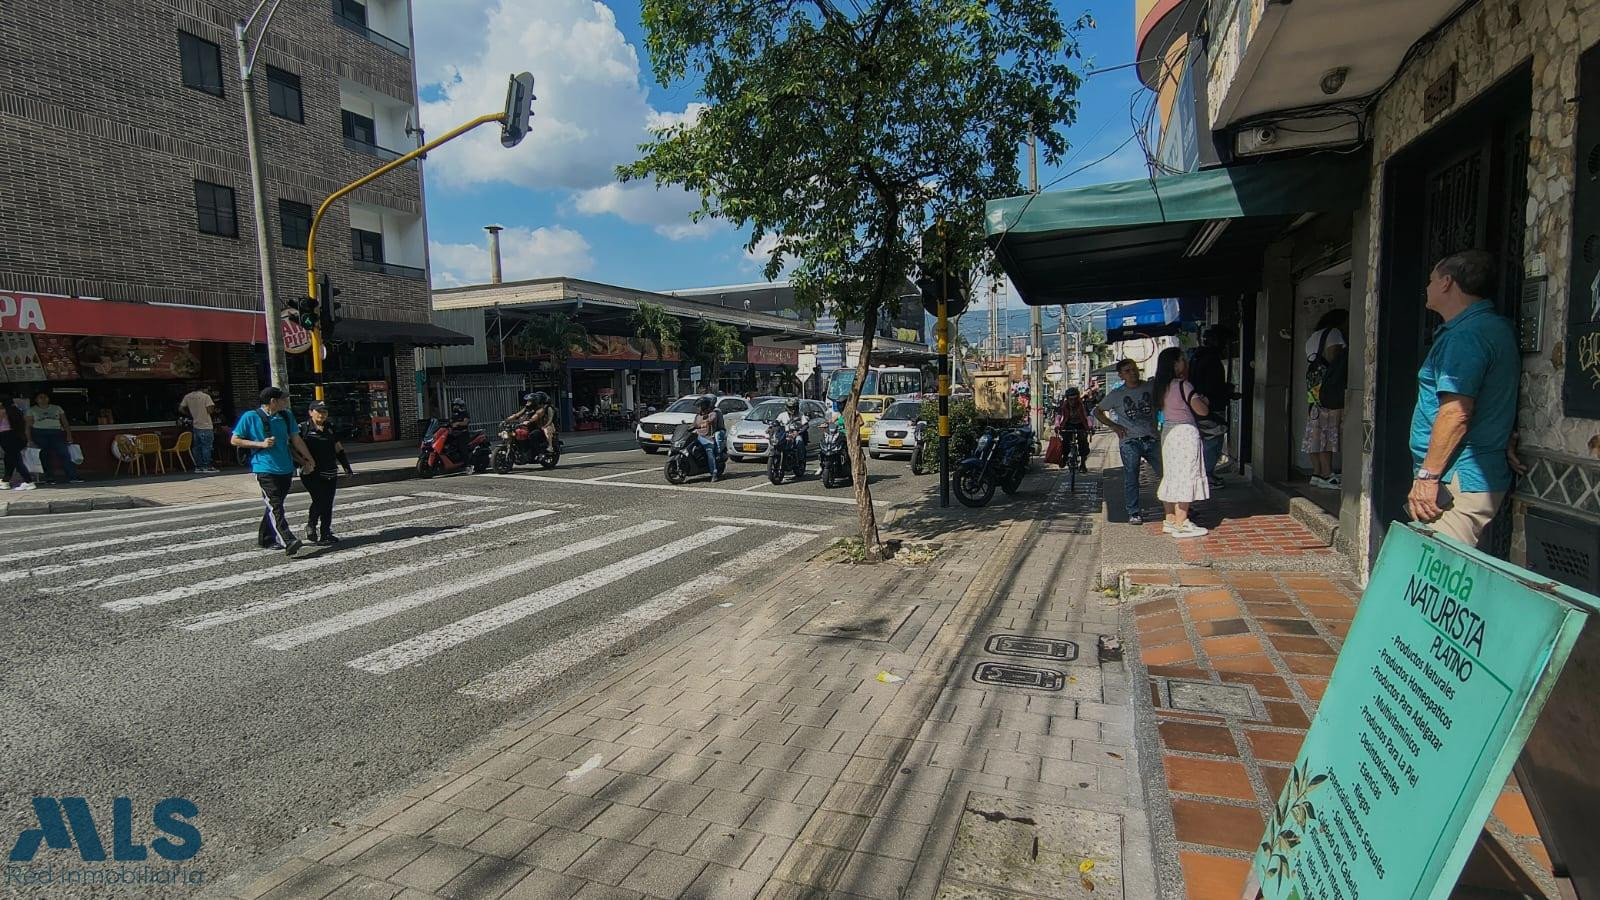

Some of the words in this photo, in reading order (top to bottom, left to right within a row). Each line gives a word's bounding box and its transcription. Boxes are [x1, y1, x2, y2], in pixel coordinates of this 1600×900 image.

[1417, 542, 1474, 602] Tienda
[1403, 574, 1486, 657] NATURISTA
[1422, 662, 1456, 701] Naturales
[1429, 635, 1473, 683] PLATINO
[1398, 694, 1413, 717] Para
[1411, 711, 1444, 752] Adelgazar
[1407, 675, 1453, 731] Homeopaticos
[1385, 737, 1399, 762] Para
[1397, 753, 1407, 772] La
[1404, 764, 1420, 789] Piel
[1315, 874, 1322, 887] Y
[1332, 844, 1344, 865] Del
[1340, 861, 1359, 900] Cabello
[1361, 832, 1386, 880] Sexuales
